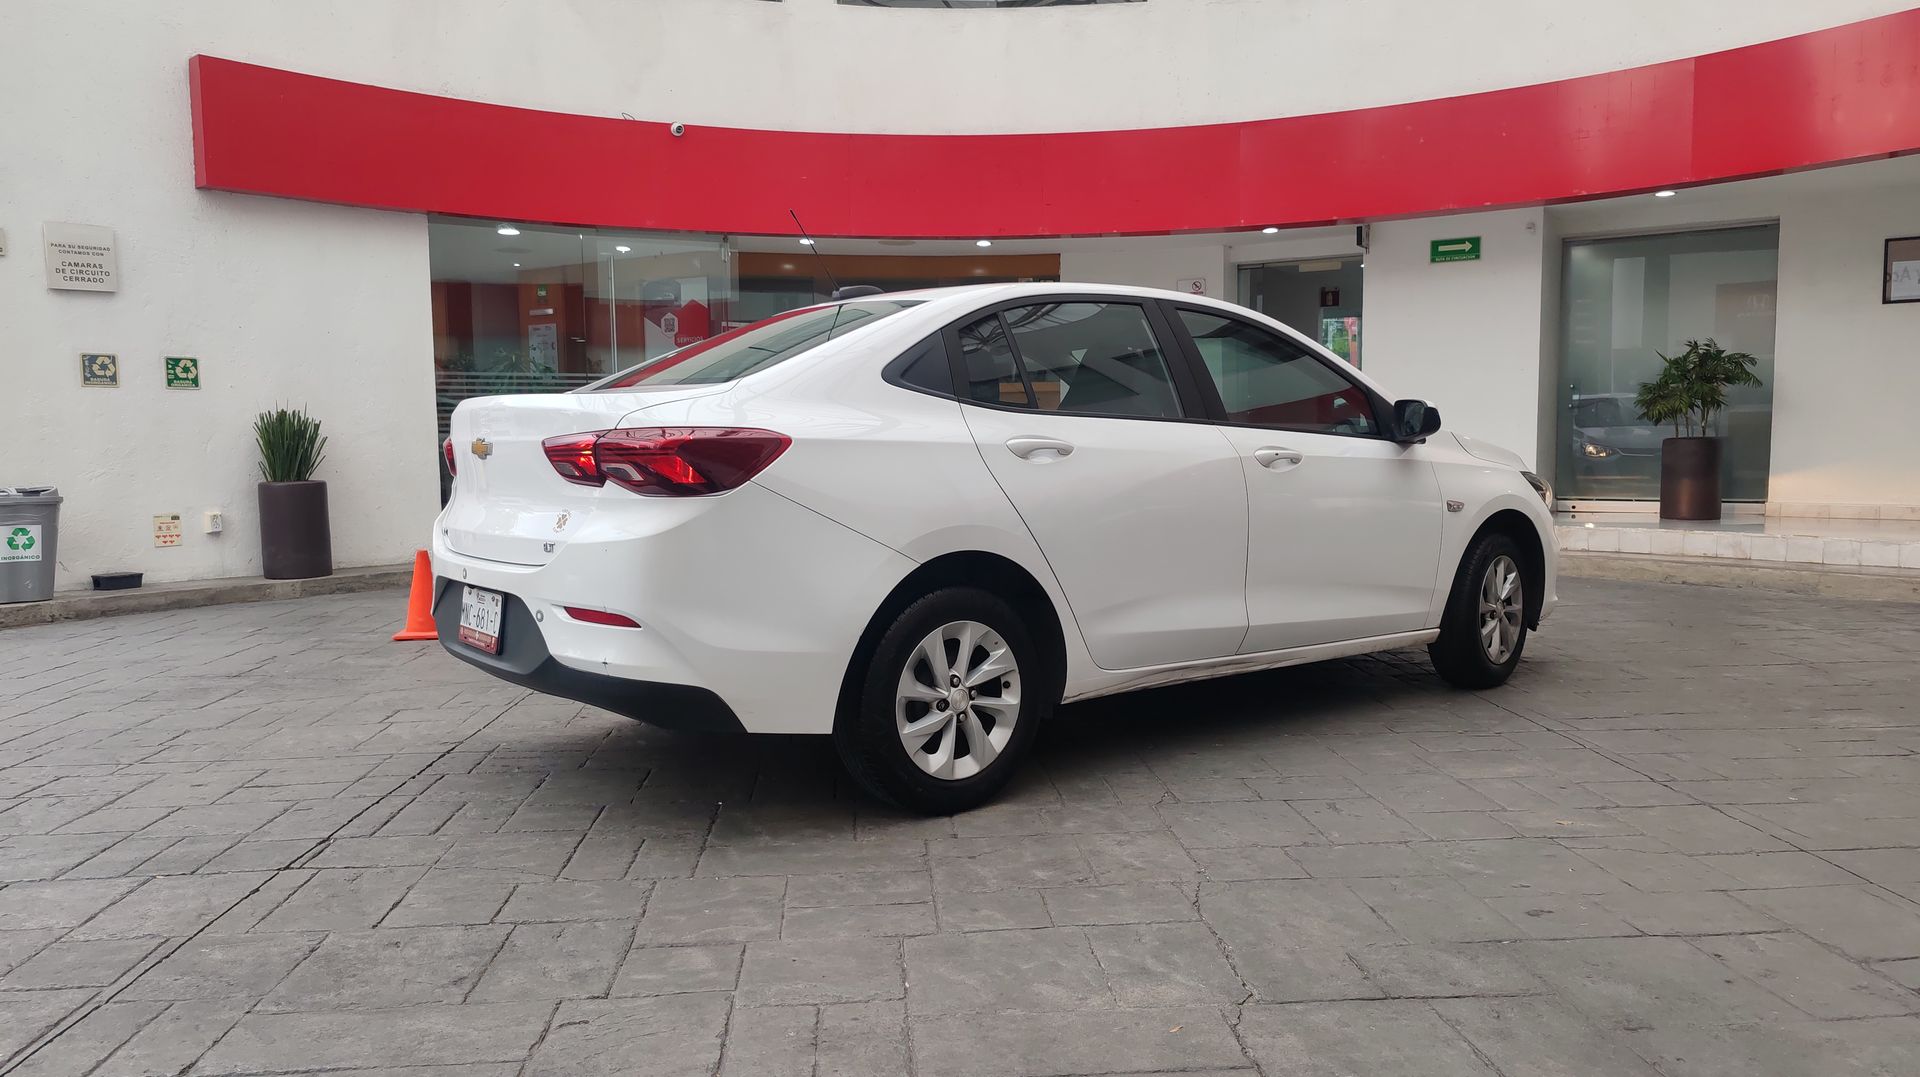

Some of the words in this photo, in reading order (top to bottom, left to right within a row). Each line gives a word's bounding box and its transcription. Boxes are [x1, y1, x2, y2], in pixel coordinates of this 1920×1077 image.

[77, 244, 111, 252] SEGURIDAD
[61, 261, 104, 270] CAMARAS
[70, 268, 110, 277] CIRCUITO
[62, 275, 105, 284] CERRADO
